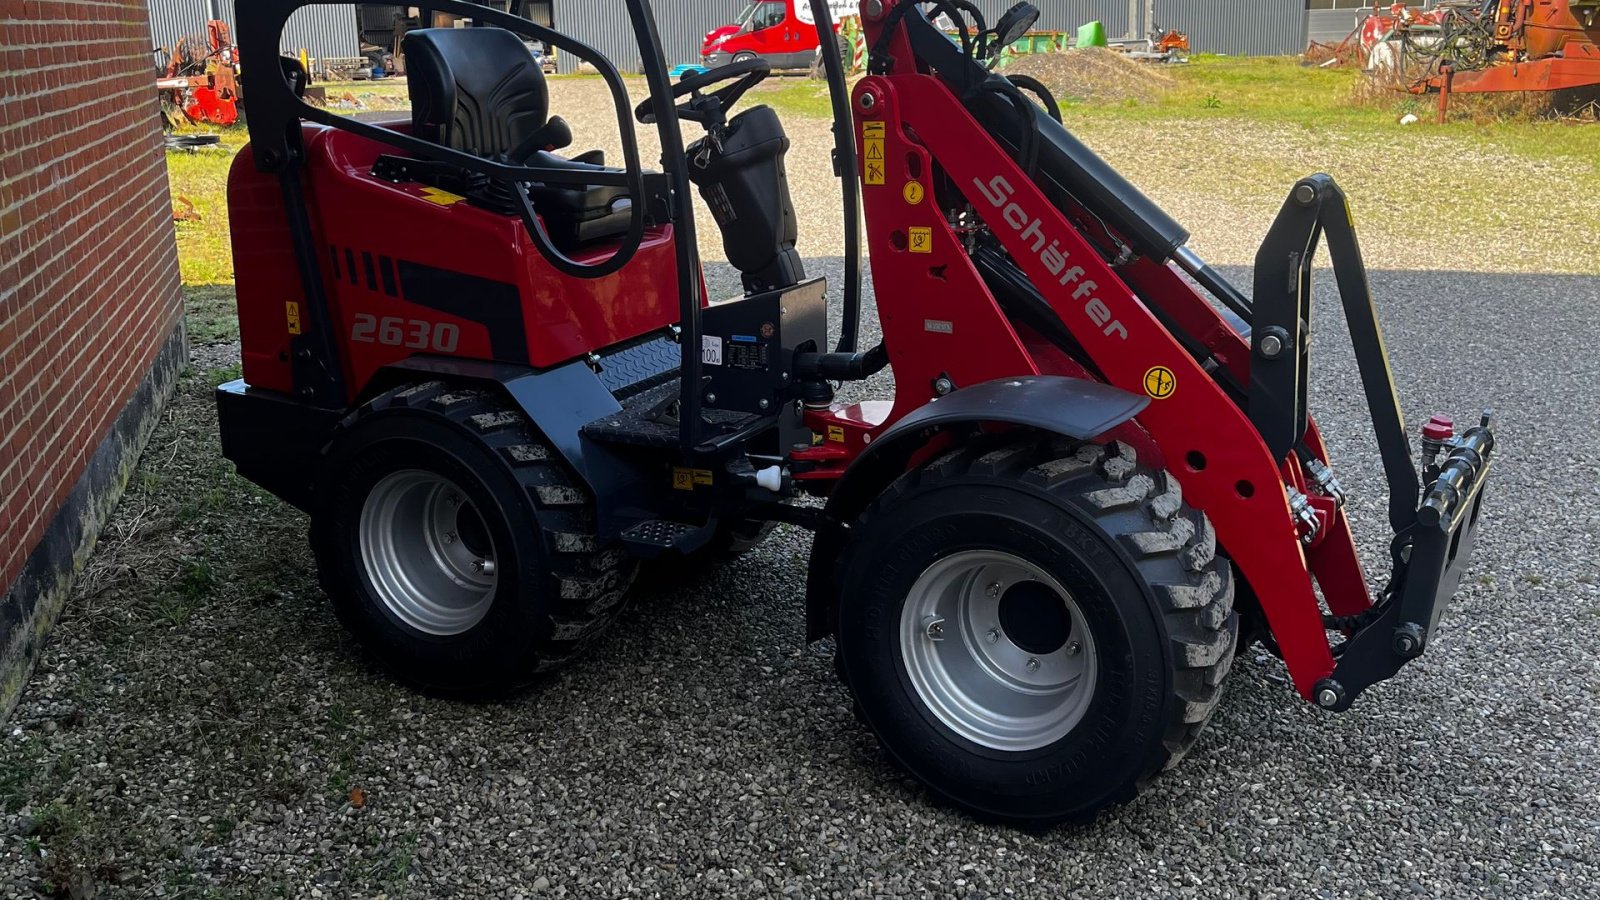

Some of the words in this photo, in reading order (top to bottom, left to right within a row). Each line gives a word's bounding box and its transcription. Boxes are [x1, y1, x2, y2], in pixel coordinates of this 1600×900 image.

[973, 176, 1128, 340] Schäffer
[352, 313, 459, 352] 2630
[1066, 525, 1102, 558] BKT
